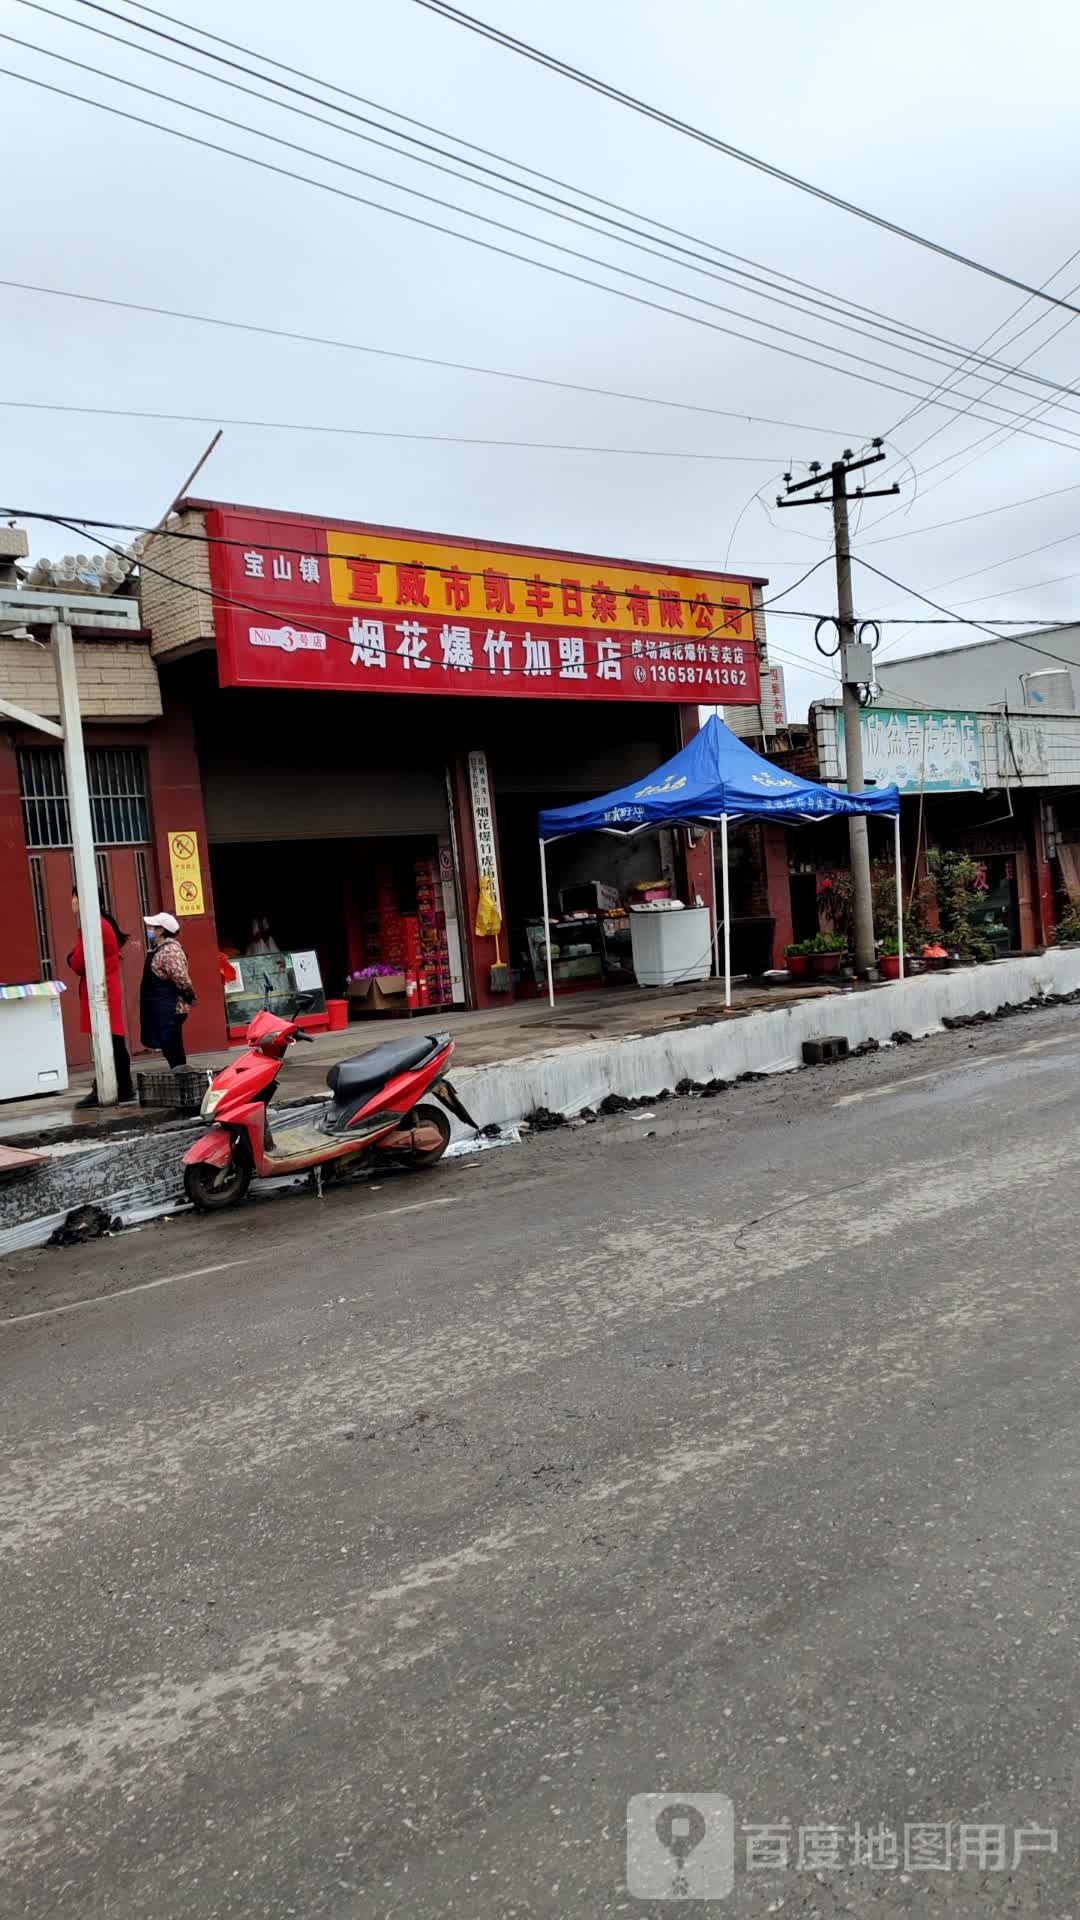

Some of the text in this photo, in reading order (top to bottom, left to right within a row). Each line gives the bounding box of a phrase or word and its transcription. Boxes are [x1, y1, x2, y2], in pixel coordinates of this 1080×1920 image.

[243, 550, 321, 584] 宝山镇
[347, 554, 743, 634] 宣威市凯丰日杂有限公司
[348, 616, 622, 681] 烟花爆竹加盟店
[631, 638, 744, 665] 虎场烟花爆竹专卖店
[650, 665, 747, 686] 13658741362
